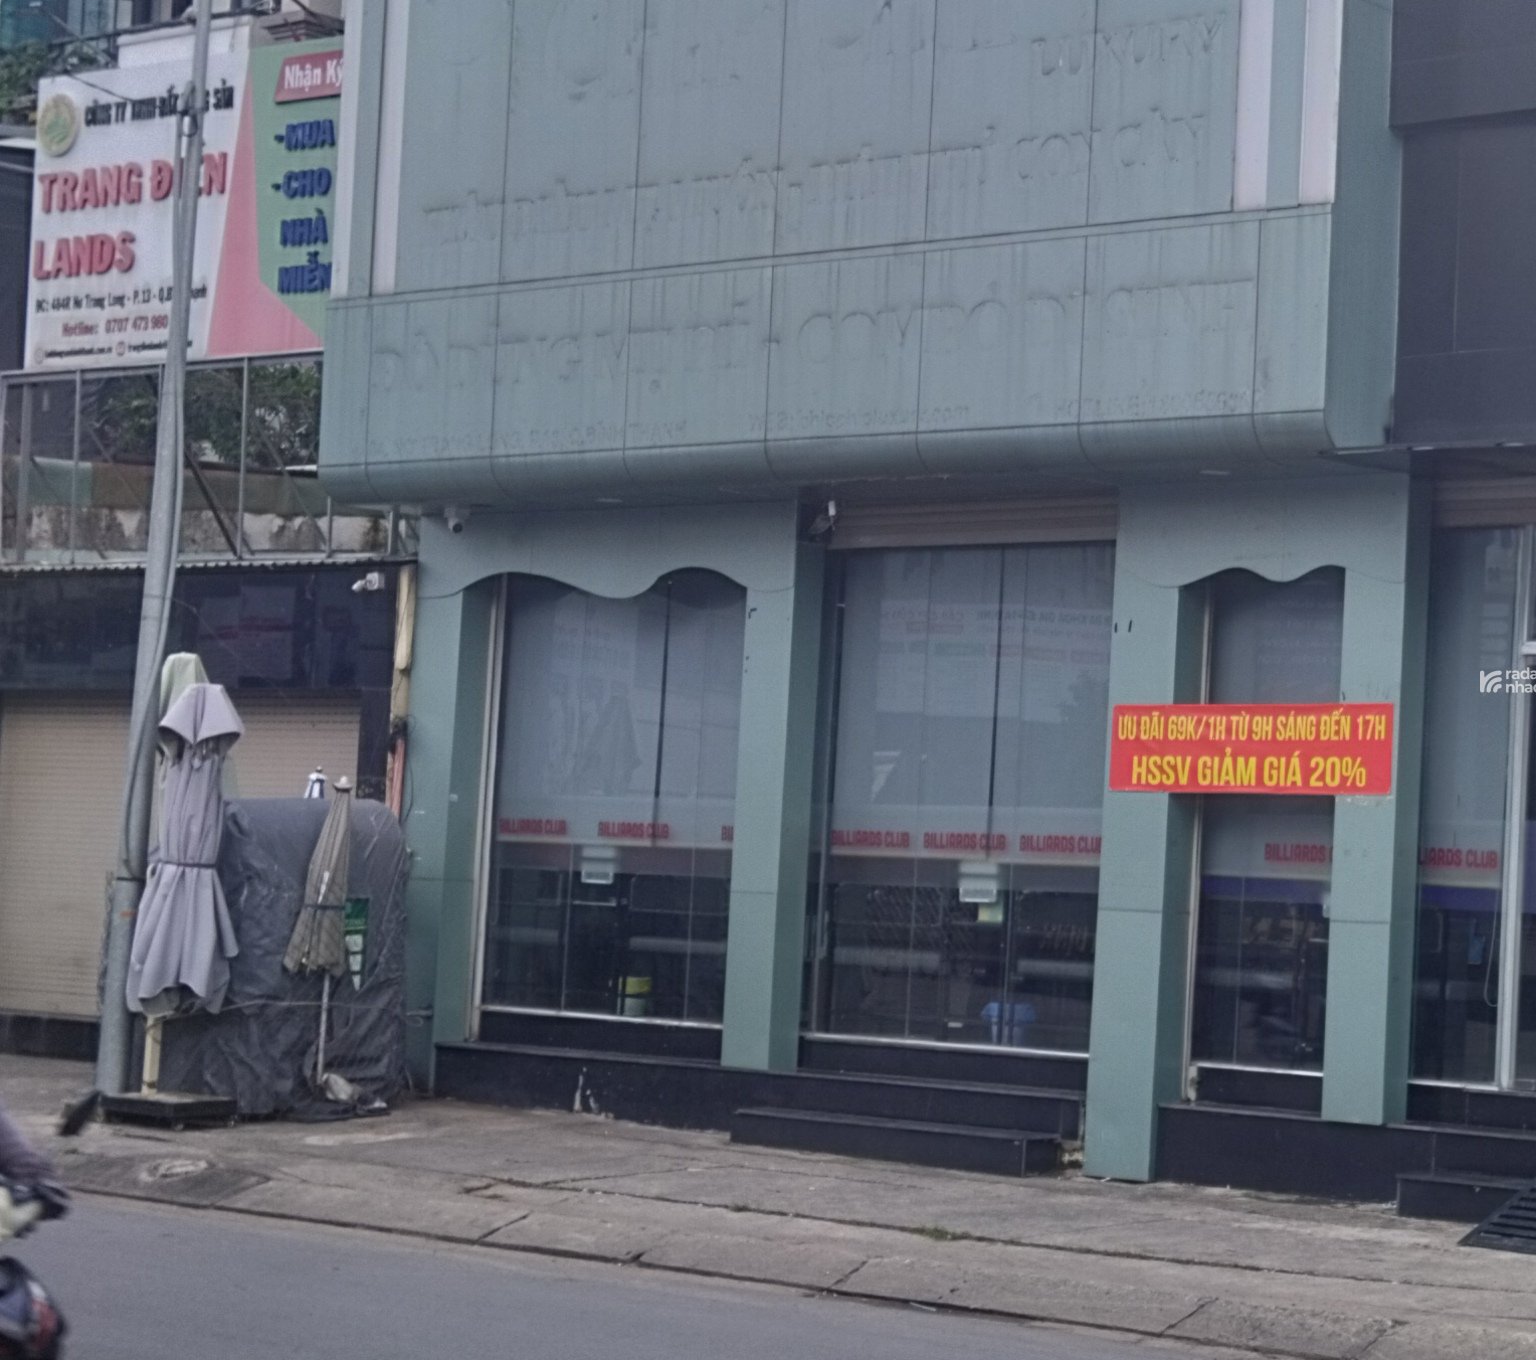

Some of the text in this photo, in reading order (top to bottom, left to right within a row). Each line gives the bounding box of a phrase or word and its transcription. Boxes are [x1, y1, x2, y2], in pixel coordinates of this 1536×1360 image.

[284, 64, 322, 91] Nhận
[38, 151, 228, 214] TRANG ĐN
[280, 207, 328, 248] NHÀ
[33, 230, 137, 281] LANDS
[1140, 711, 1165, 741] ĐÃI
[1252, 715, 1273, 741] 9H
[1276, 710, 1317, 742] SÁNG
[1319, 707, 1351, 742] ĐẾN
[1357, 714, 1386, 742] 17H
[1132, 747, 1366, 788] HSSV GIẢM GIÁ 20%
[1264, 843, 1326, 863] BILLIARDS
[1465, 848, 1498, 869] CLUB
